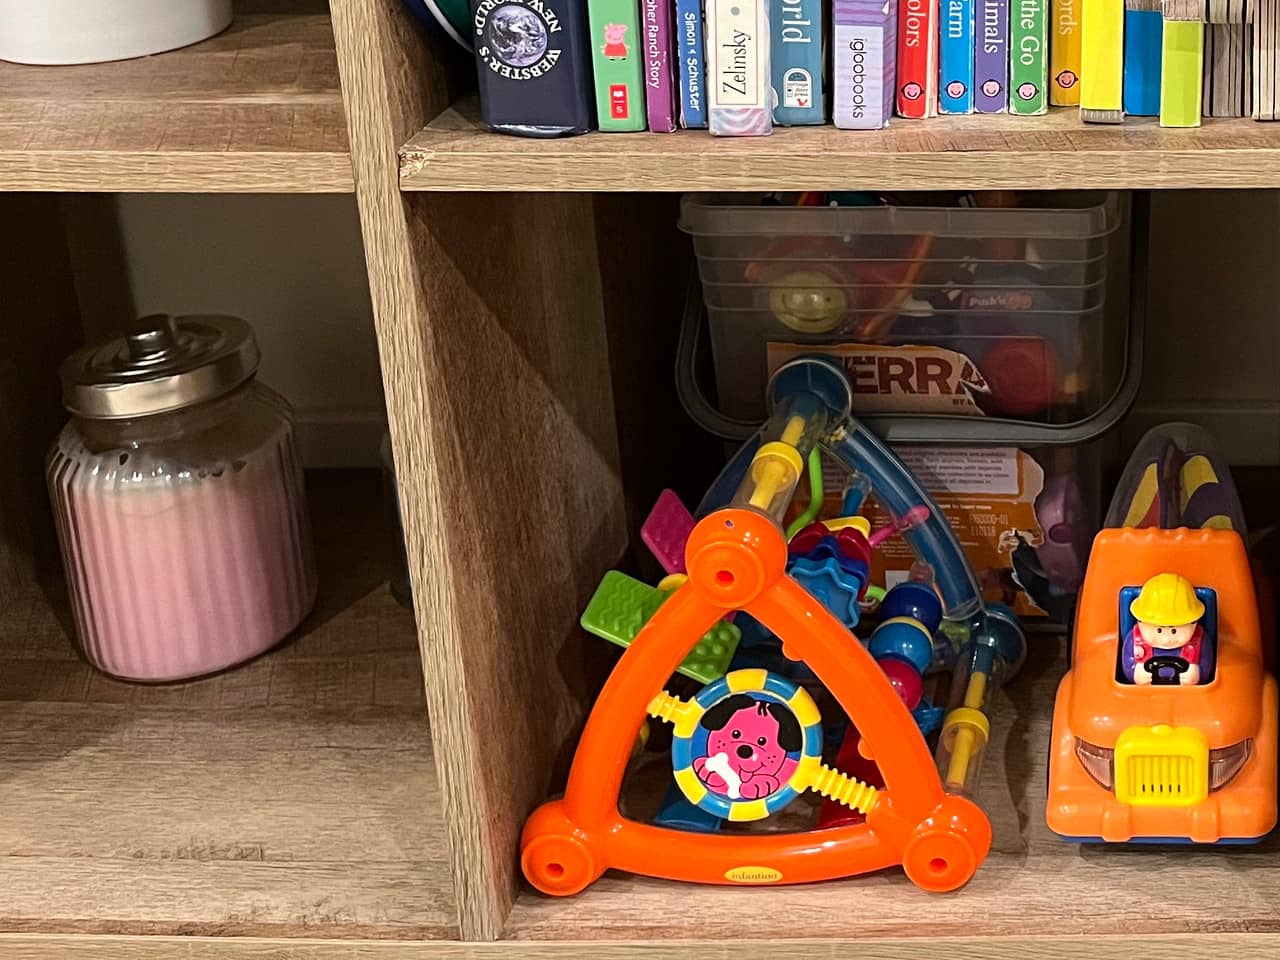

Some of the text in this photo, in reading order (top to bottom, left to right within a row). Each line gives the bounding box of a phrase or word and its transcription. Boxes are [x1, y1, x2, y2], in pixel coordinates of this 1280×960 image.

[1020, 0, 1041, 30] the
[647, 17, 661, 58] Ranch
[1019, 35, 1040, 66] Go
[478, 45, 562, 81] WEBSTER'S
[648, 59, 663, 90] Story
[683, 11, 700, 112] Simon Schuster
[722, 28, 752, 96] Zelinsky
[849, 37, 865, 119] igloobooks
[843, 355, 985, 396] ERRA
